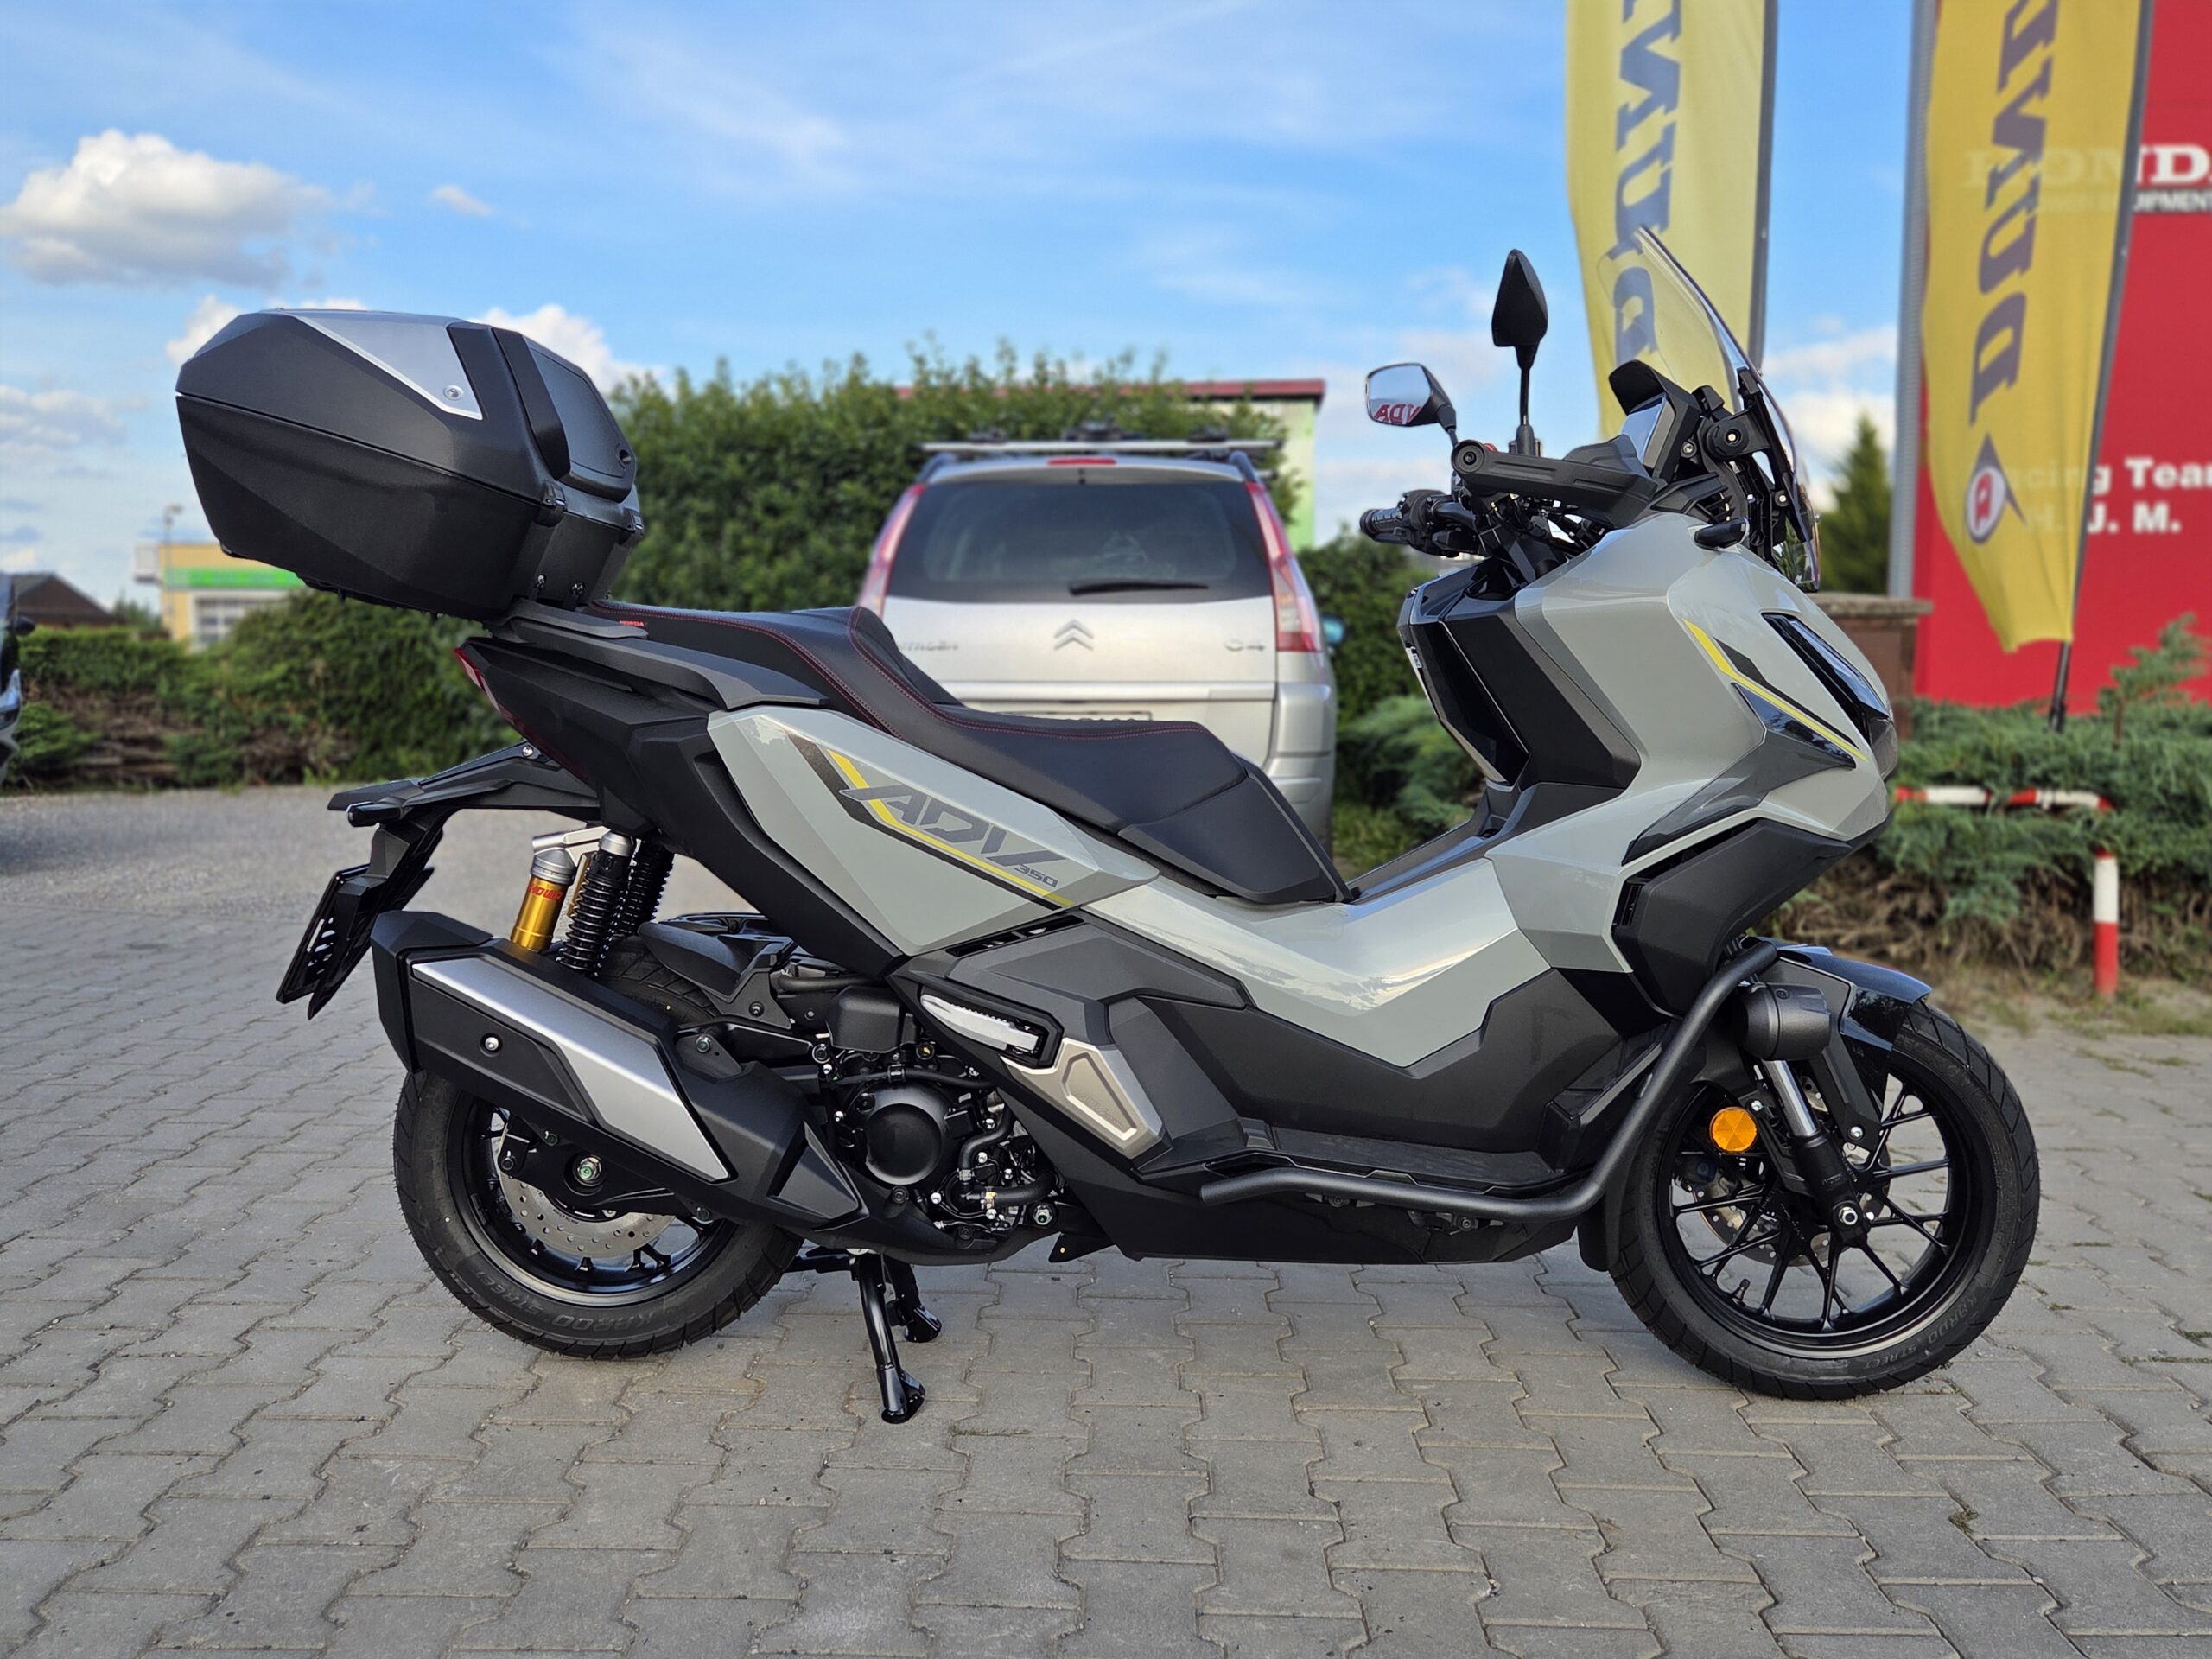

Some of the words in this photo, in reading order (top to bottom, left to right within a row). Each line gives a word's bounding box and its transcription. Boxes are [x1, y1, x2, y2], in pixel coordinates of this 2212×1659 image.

[2124, 456, 2212, 490] Tea
[2132, 501, 2182, 534] M.
[839, 783, 1068, 868] ADV
[1014, 864, 1059, 888] 350
